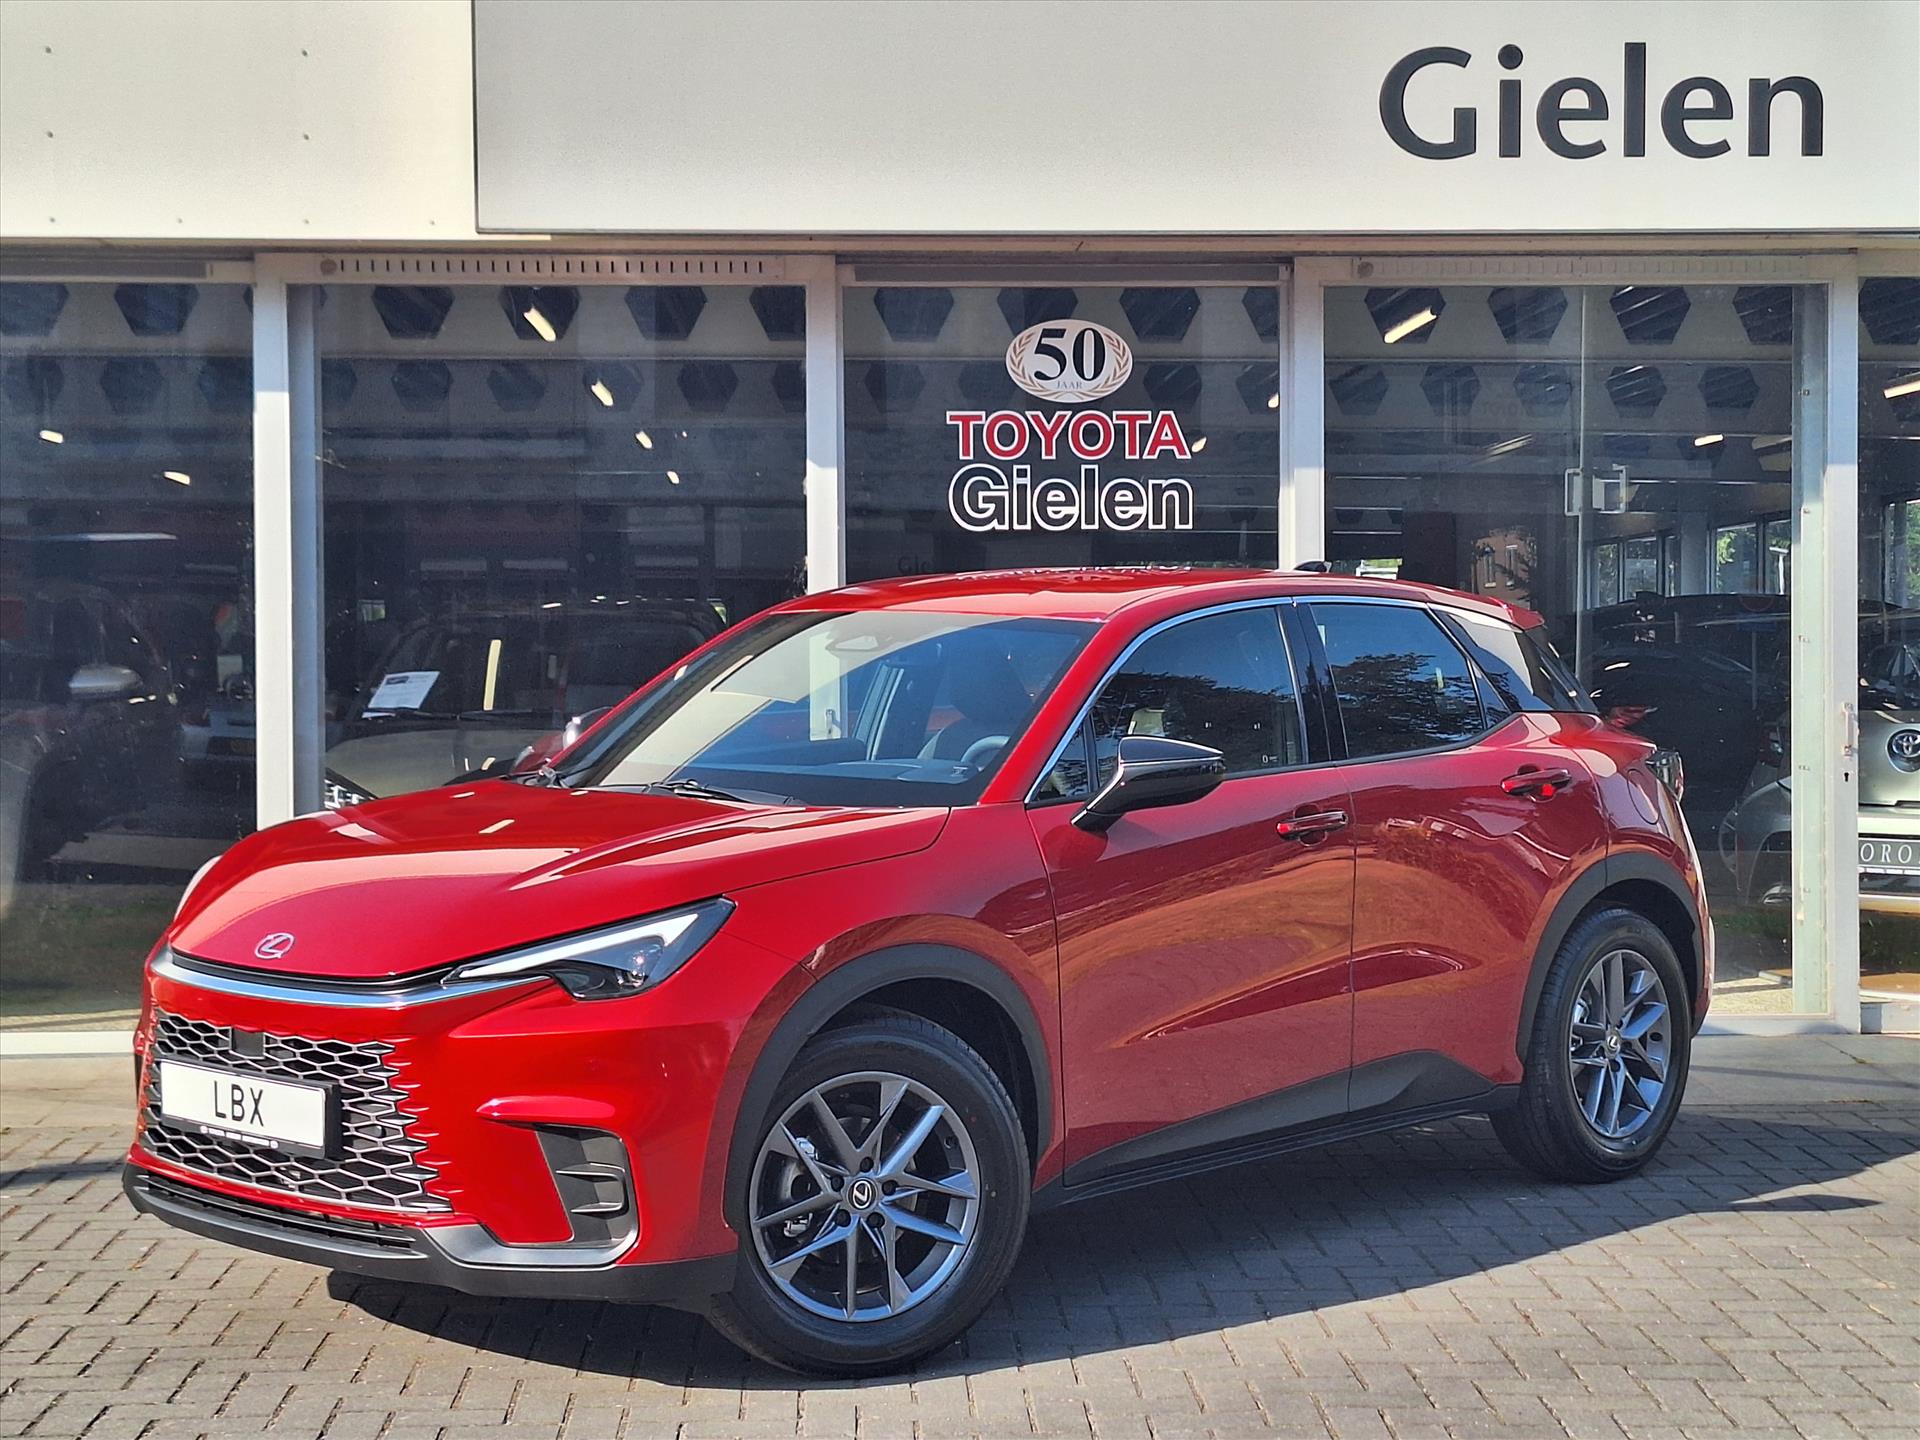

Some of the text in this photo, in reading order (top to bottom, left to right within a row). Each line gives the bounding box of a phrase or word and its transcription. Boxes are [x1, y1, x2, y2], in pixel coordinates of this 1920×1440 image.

[1379, 41, 1824, 160] Gielen
[1033, 327, 1107, 382] 50
[1056, 379, 1083, 390] JAAR
[946, 410, 1191, 460] TOYOTA
[949, 463, 1194, 531] Gielen
[1860, 842, 1920, 864] ORO
[213, 1080, 264, 1127] LBX
